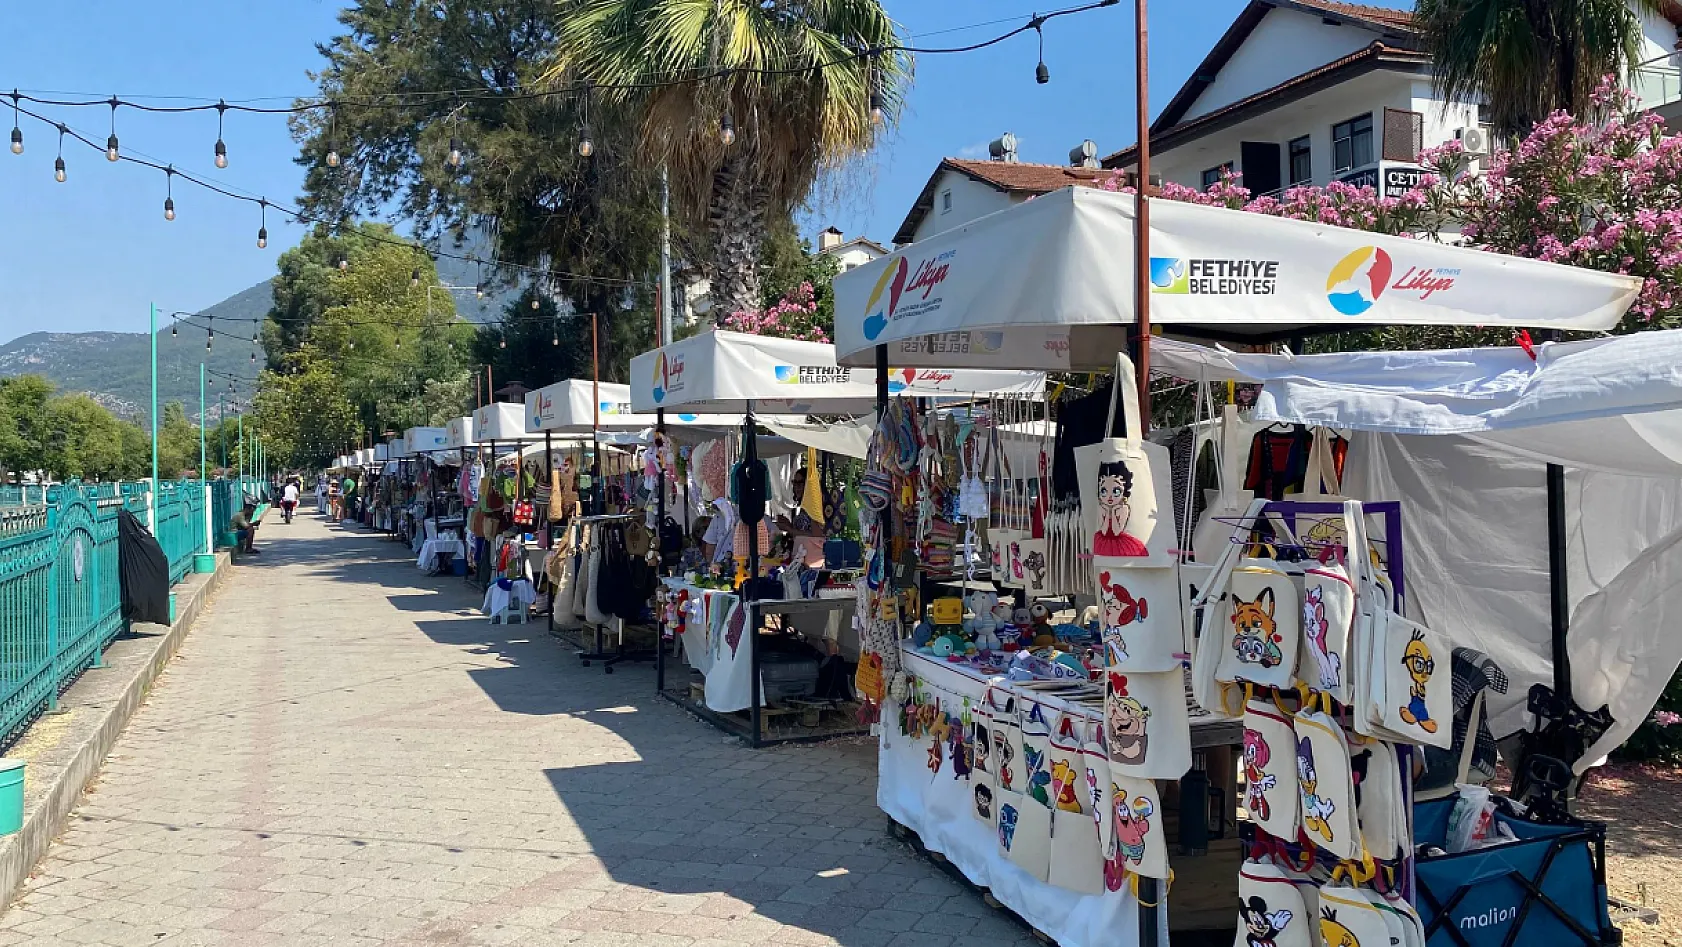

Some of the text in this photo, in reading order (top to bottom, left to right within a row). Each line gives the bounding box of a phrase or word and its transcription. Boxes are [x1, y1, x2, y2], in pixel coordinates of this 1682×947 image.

[905, 257, 950, 300] Likya
[1392, 266, 1455, 300] Likya
[917, 369, 953, 384] Likya
[1460, 906, 1516, 929] malion
